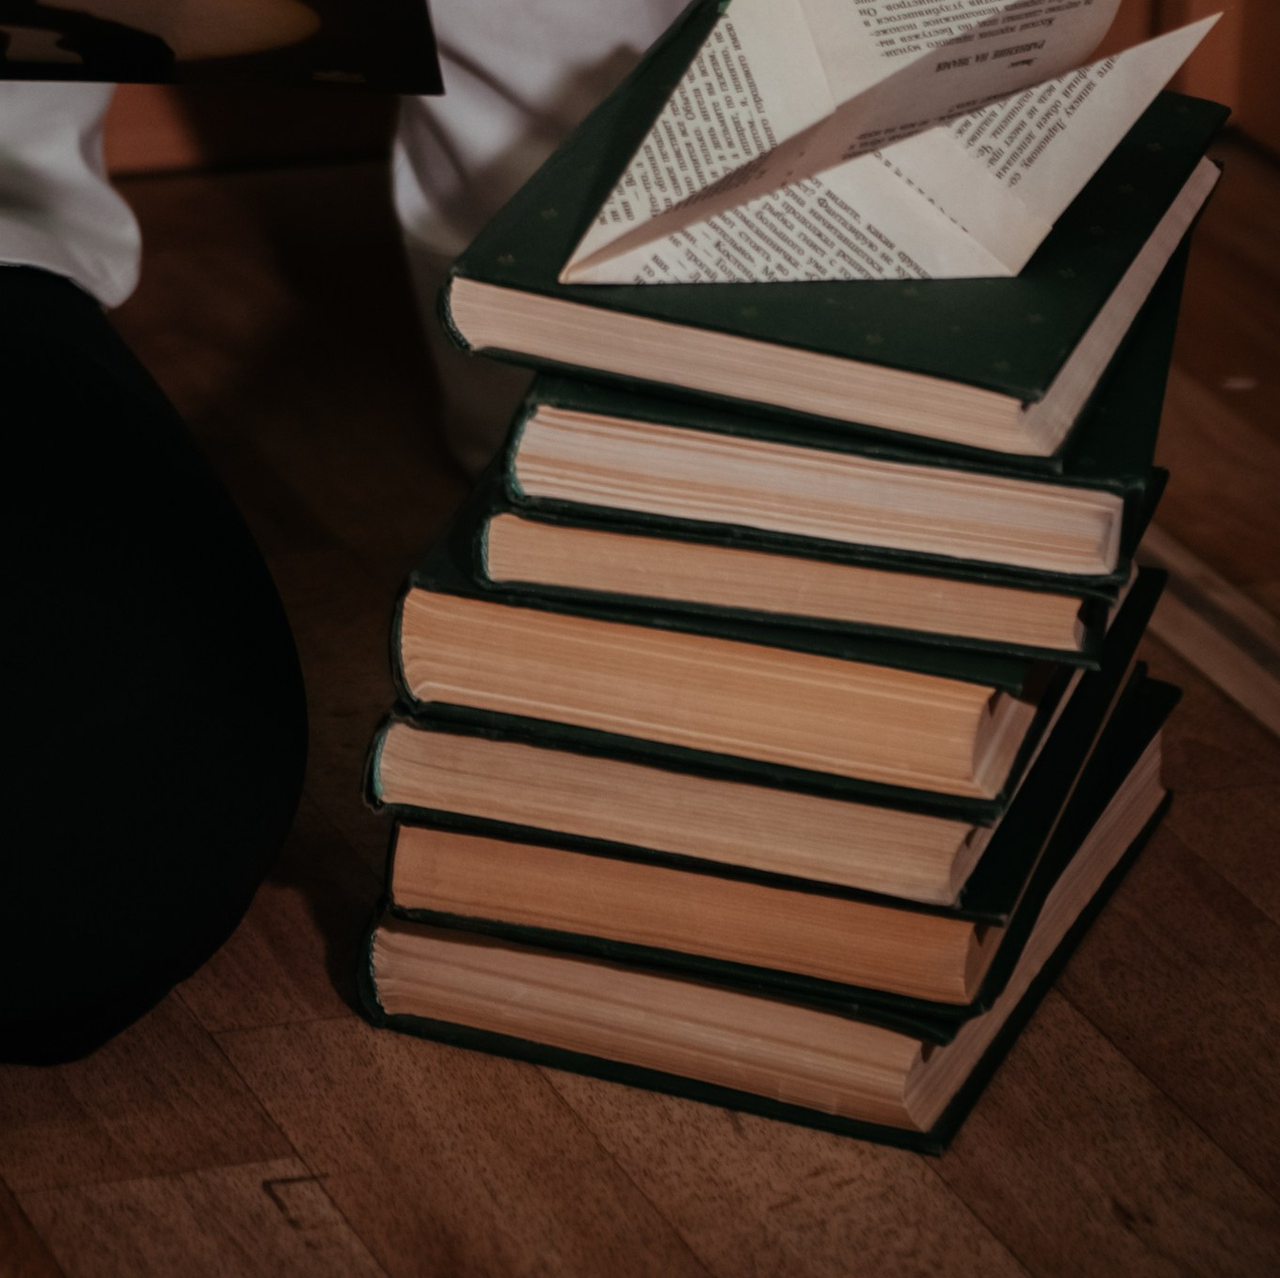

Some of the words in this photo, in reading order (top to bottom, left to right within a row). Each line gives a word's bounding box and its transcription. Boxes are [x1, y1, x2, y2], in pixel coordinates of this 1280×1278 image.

[858, 7, 877, 17] Он
[876, 3, 964, 24] углубившегося
[922, 6, 1000, 28] неподвижное
[900, 26, 954, 43] Бестужев
[1063, 81, 1097, 119] записку
[1036, 99, 1062, 130] обмен
[995, 130, 1037, 180] депешами
[1021, 118, 1067, 170] Ларионову,
